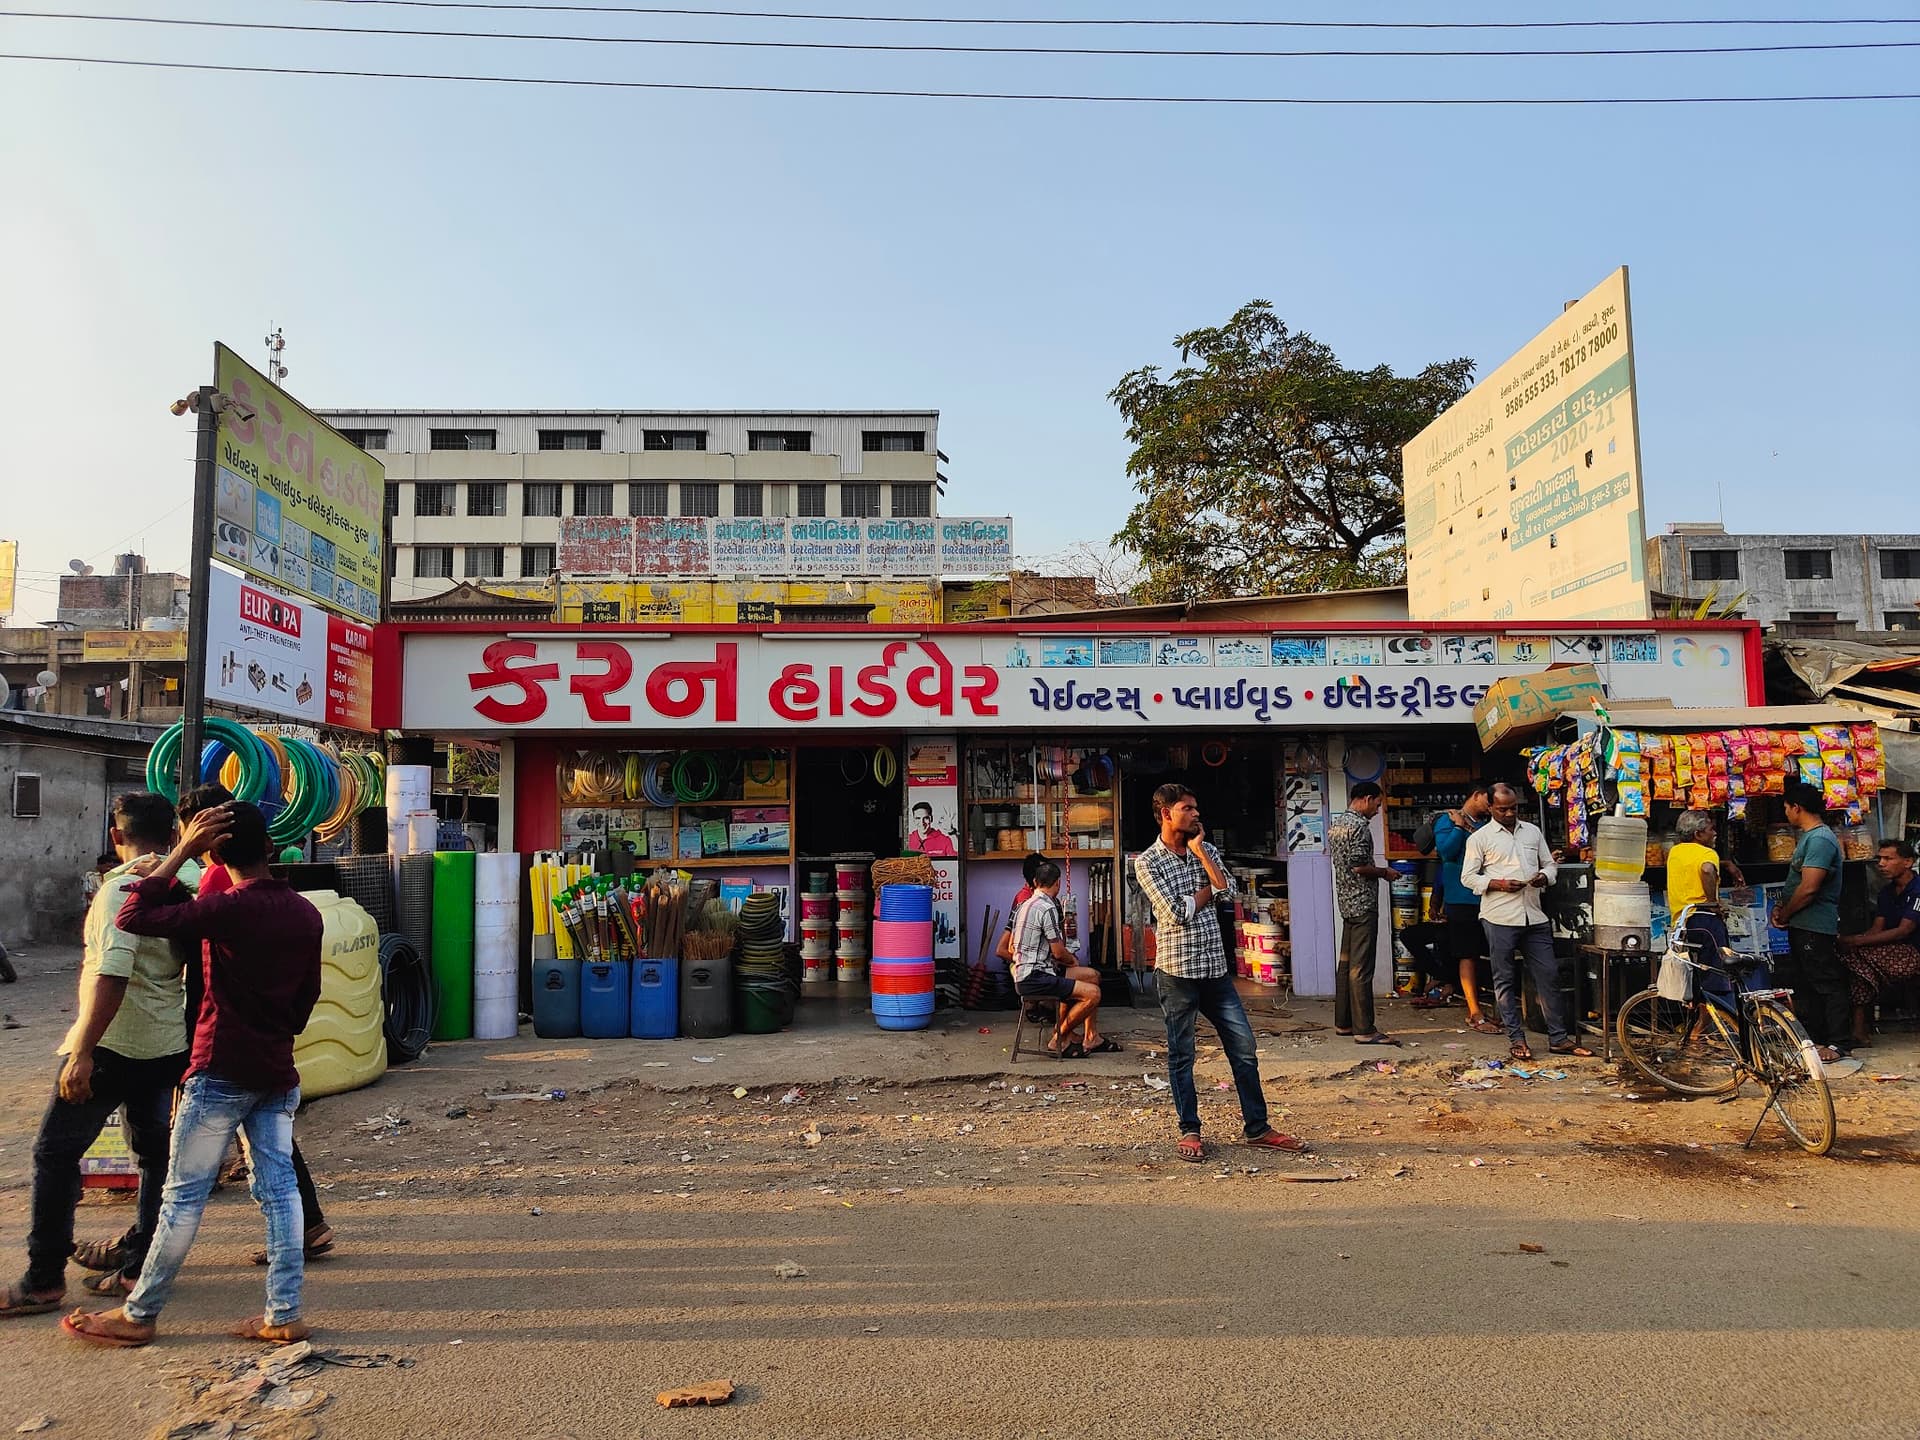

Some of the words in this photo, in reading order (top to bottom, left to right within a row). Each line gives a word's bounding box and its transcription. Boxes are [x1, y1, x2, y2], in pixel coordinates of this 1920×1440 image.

[1505, 393, 1524, 419] 9586
[1525, 381, 1539, 405] 555
[1559, 345, 1586, 378] 78178
[1588, 322, 1618, 357] 78000
[240, 623, 269, 643] ANTI-THEFT
[269, 630, 301, 652] ENGINEERING
[345, 628, 367, 650] KARAN
[468, 640, 738, 724] કરન
[768, 640, 1000, 724] હાર્ડવેર
[332, 933, 376, 957] PLASTO
